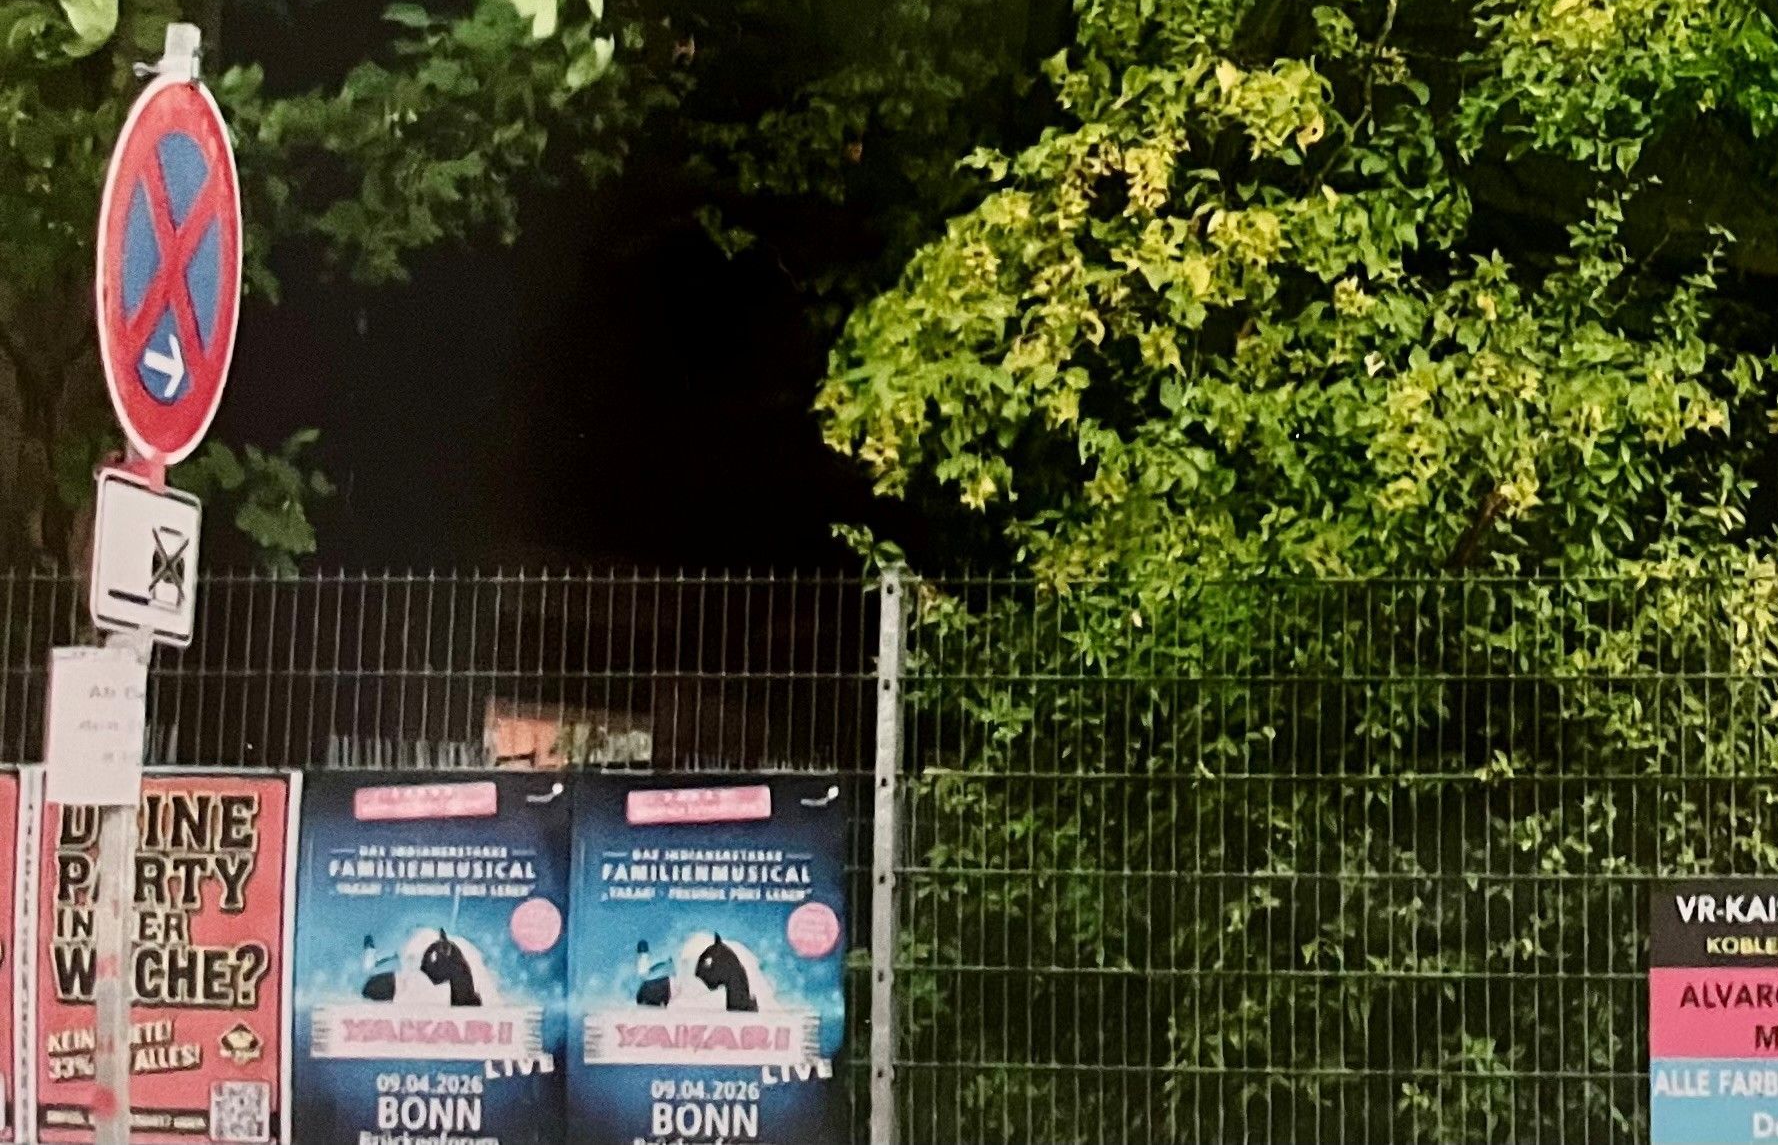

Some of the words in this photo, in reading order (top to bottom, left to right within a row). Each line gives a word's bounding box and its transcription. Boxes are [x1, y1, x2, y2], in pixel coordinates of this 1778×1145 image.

[59, 793, 256, 850] DINE
[56, 853, 253, 911] PRTY
[329, 859, 536, 879] FAMILIENMUSICAL
[602, 862, 812, 883] FAMILIENMUSICAL
[57, 909, 94, 938] IN
[54, 945, 266, 1004] WCHE?
[341, 1018, 514, 1044] YAKARI
[615, 1023, 791, 1051] YAKARI
[485, 1052, 555, 1079] LIVE
[761, 1058, 833, 1086] LIVE
[376, 1072, 484, 1094] 09.04.2026
[651, 1080, 760, 1101] 09.04.2026
[1654, 1069, 1711, 1097] ALLE
[378, 1096, 482, 1132] BONN
[652, 1101, 759, 1137] BONN
